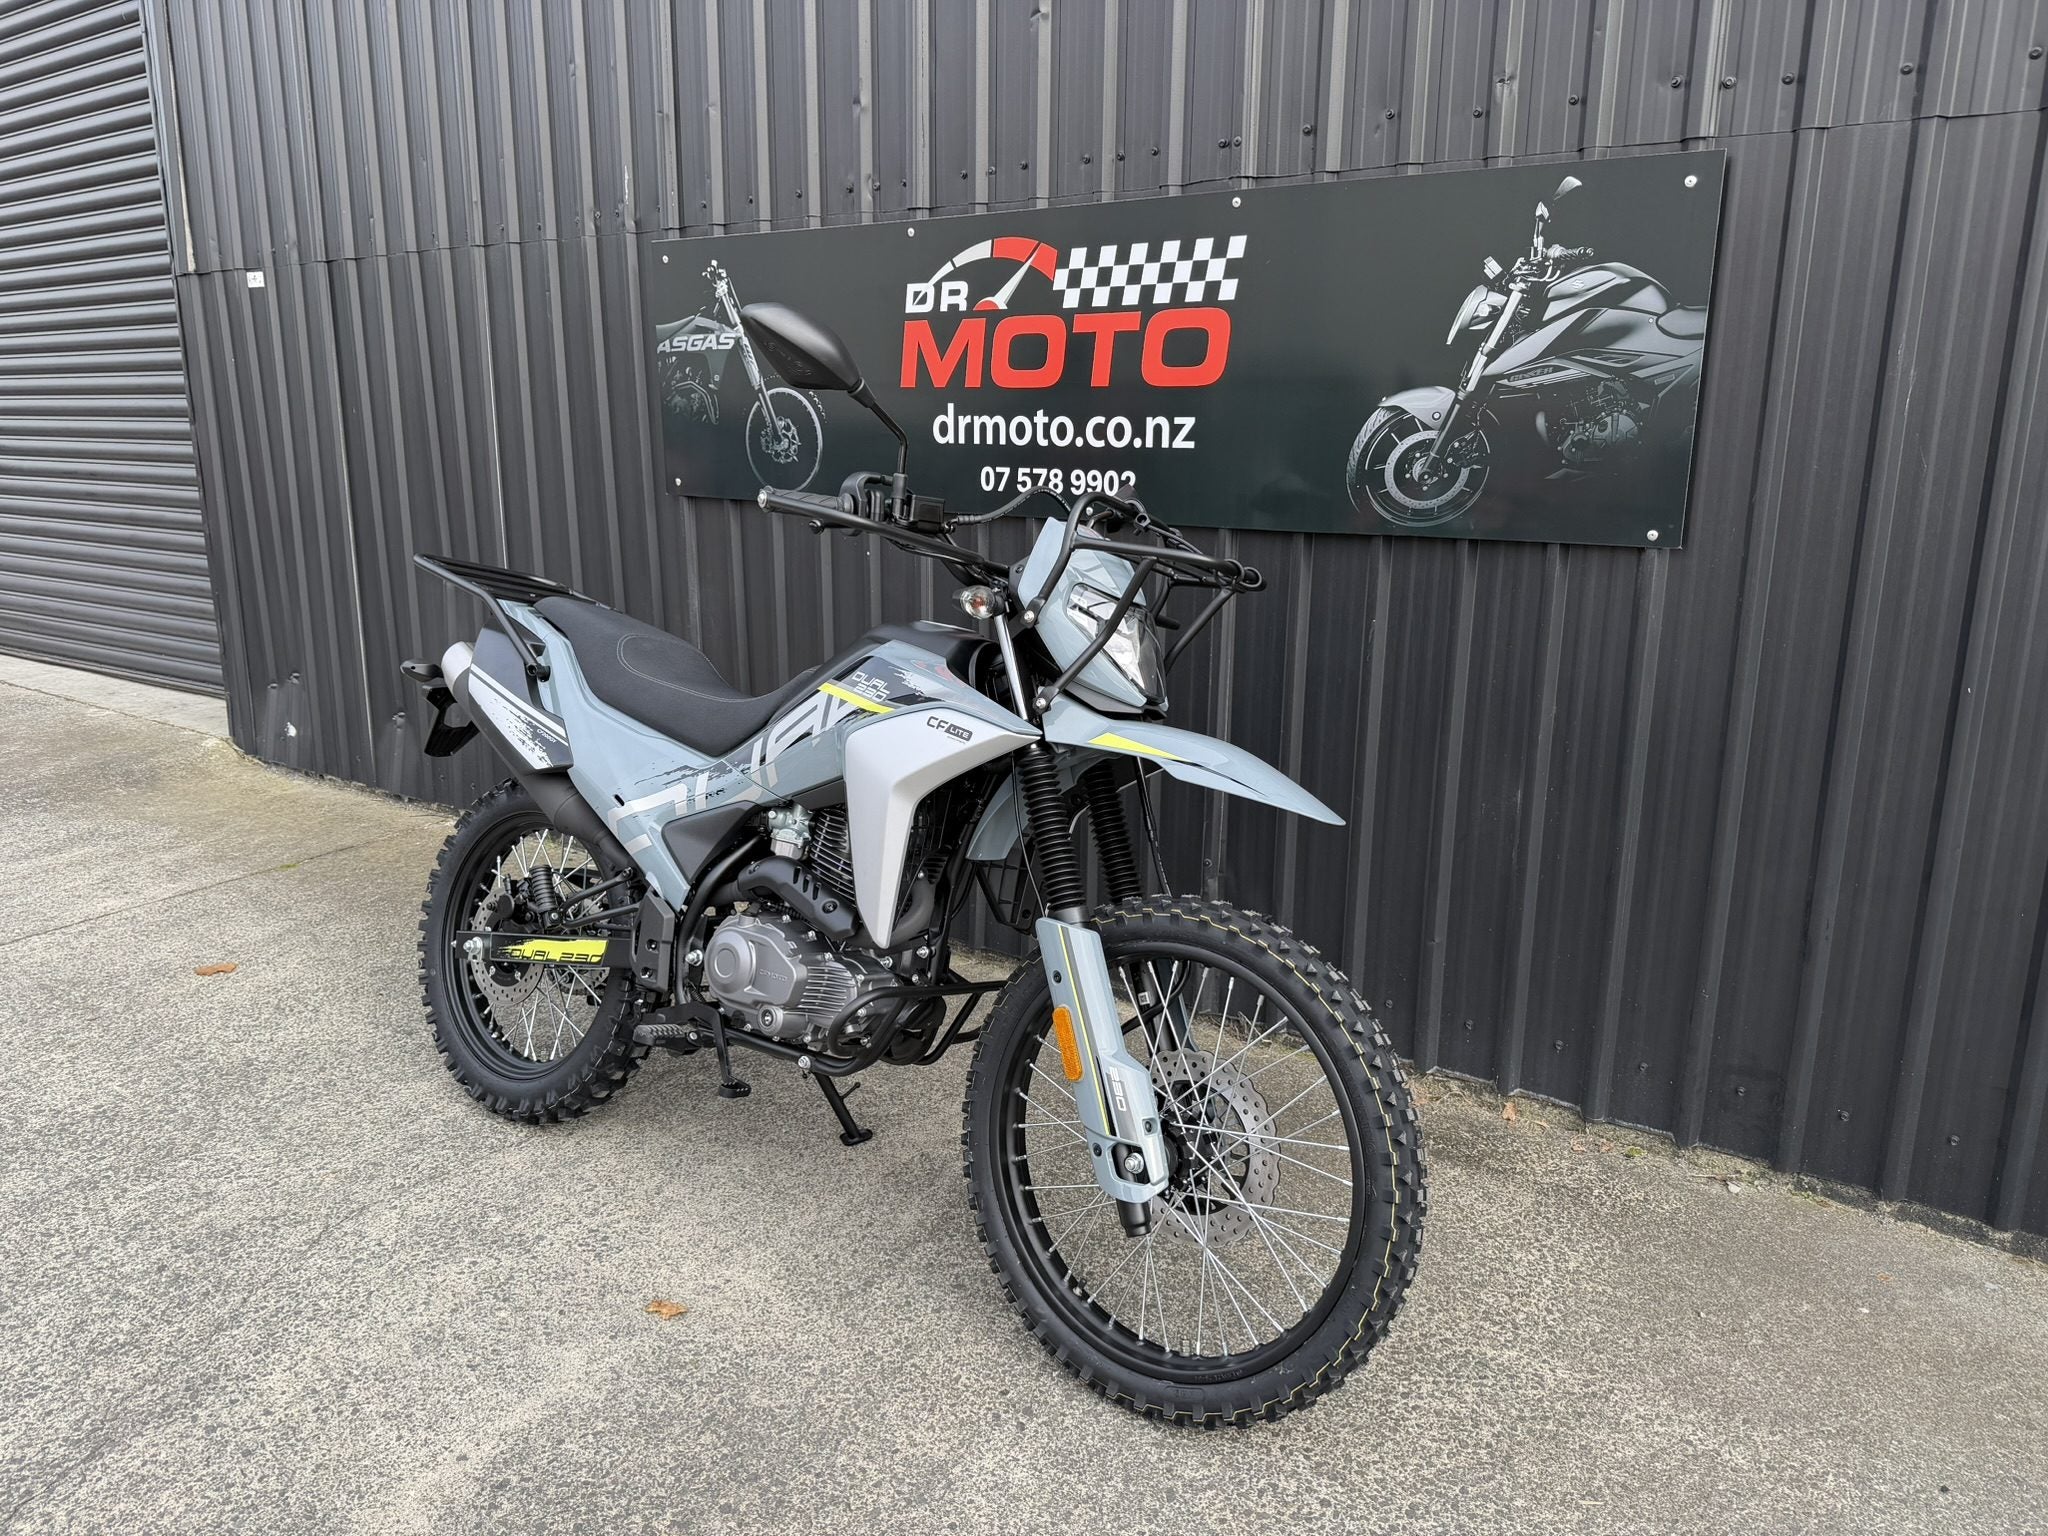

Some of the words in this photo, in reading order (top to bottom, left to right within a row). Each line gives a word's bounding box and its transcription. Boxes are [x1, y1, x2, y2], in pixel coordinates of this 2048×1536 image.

[905, 280, 968, 313] DR
[657, 333, 736, 353] ASGAS
[900, 307, 1231, 388] MOTO
[932, 403, 1196, 449] drmoto.co.nz
[980, 466, 1011, 492] 07
[1016, 467, 1064, 494] 578
[851, 671, 890, 695] DUAL
[853, 683, 887, 702] 230
[927, 716, 949, 729] CF
[948, 725, 971, 740] LITE
[510, 948, 557, 962] DUAL
[560, 952, 603, 964] 230
[1109, 1066, 1127, 1112] 230
